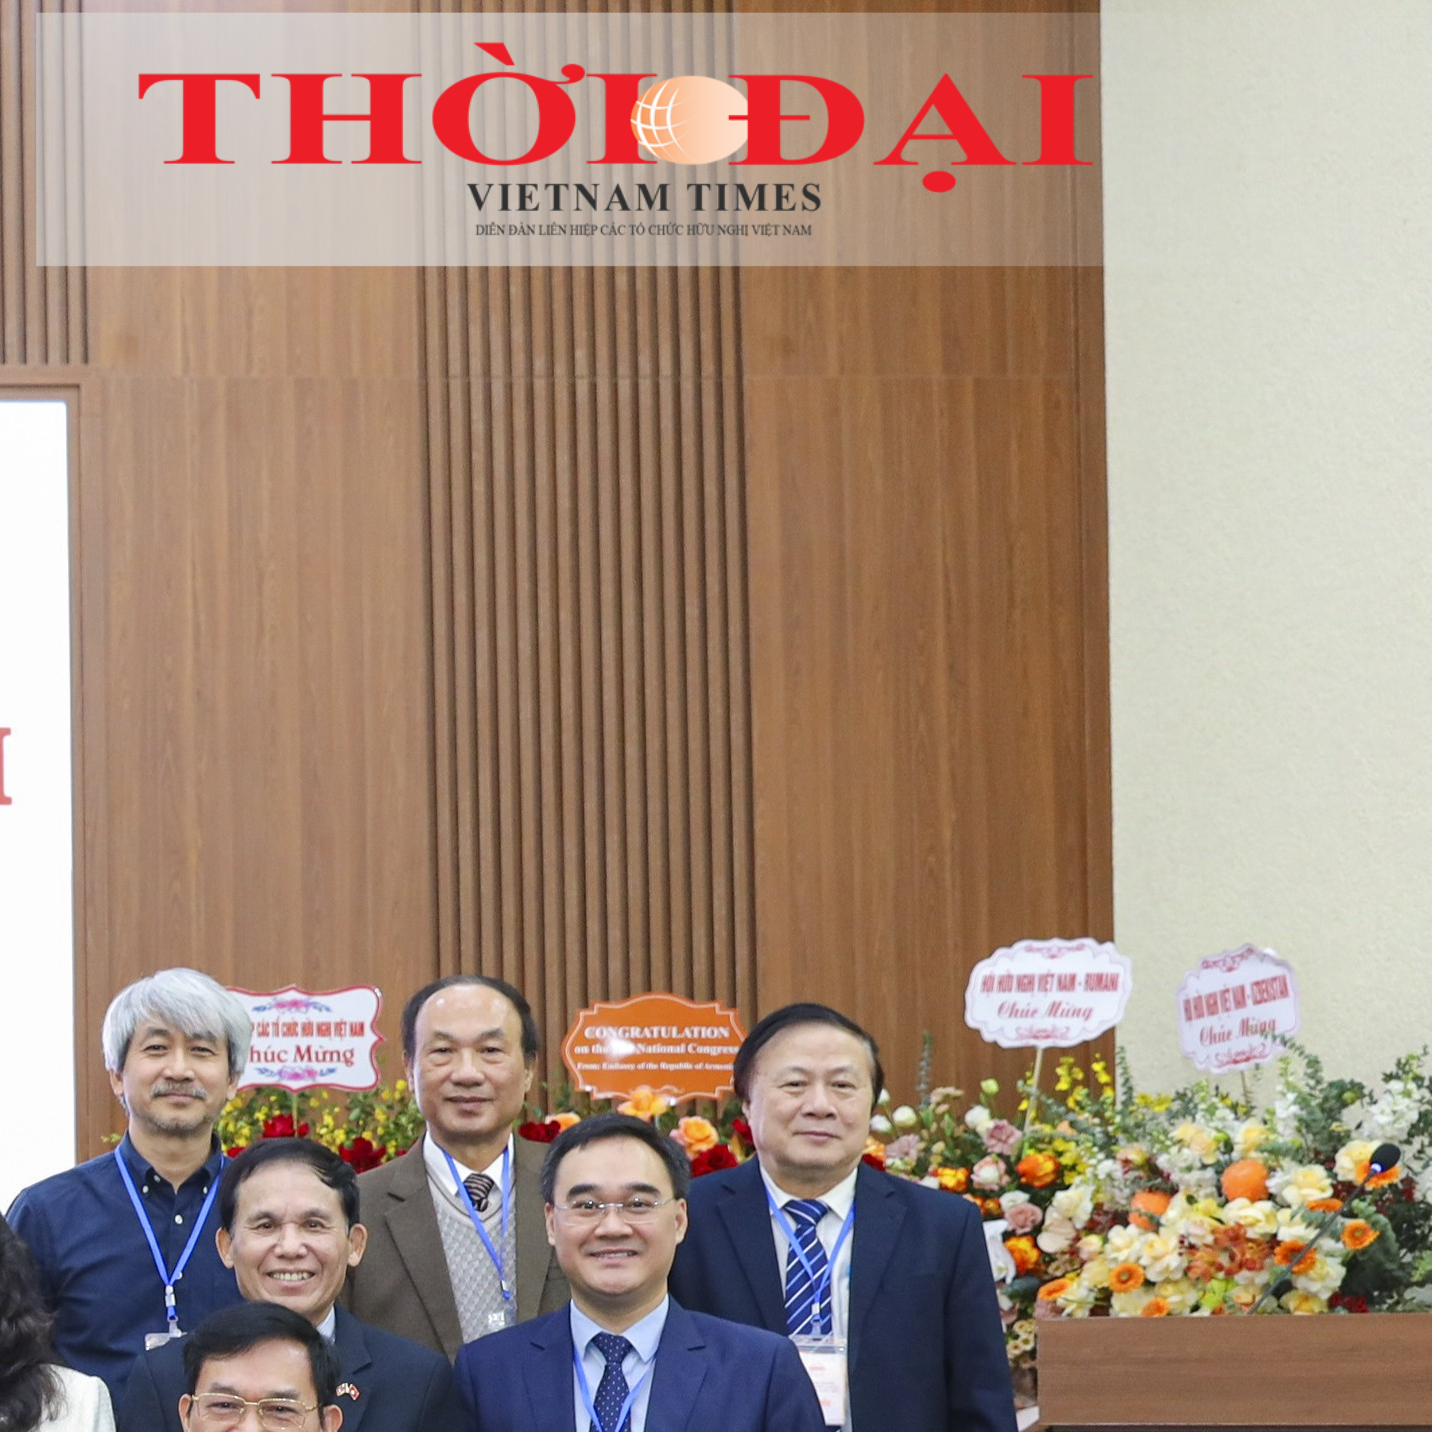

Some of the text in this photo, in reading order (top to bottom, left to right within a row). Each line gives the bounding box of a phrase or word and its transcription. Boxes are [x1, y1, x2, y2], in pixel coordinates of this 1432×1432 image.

[584, 1026, 730, 1039] CONGRATULATION
[249, 1045, 355, 1067] húc Mừng
